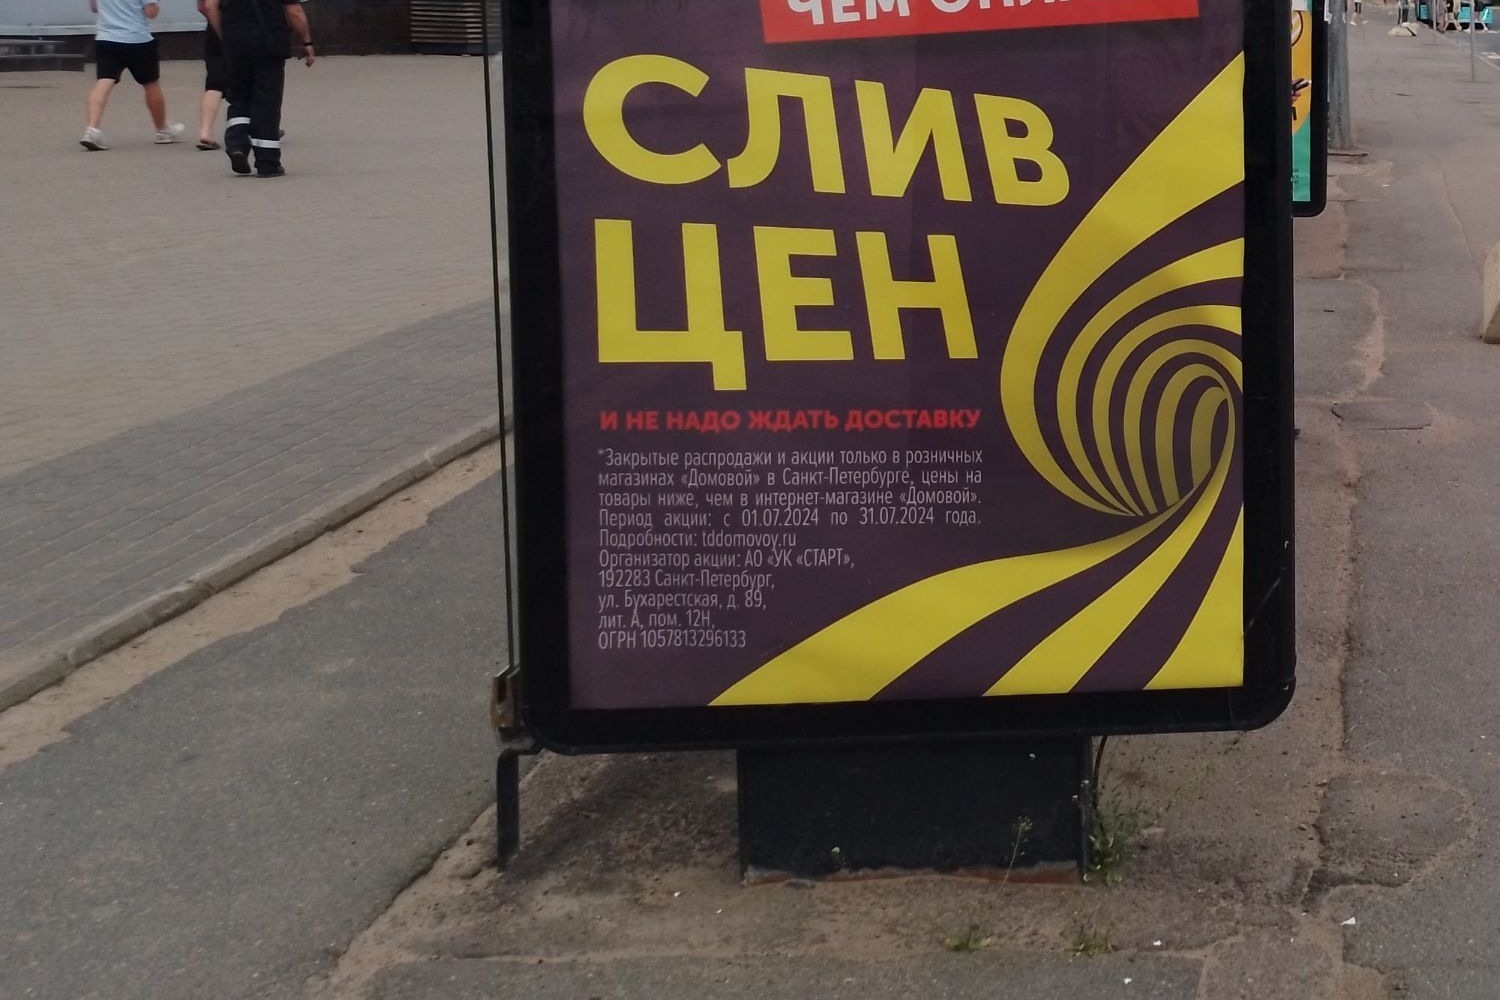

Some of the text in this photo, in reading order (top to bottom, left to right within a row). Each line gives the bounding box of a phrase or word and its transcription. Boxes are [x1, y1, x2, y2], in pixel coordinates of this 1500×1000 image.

[583, 54, 1070, 206] СЛИВ
[594, 218, 979, 391] ЦЕН
[600, 408, 982, 433] И НЕ НАДО ЖДАТЬ ДОСТАВКУ
[684, 451, 772, 469] распродажи
[777, 452, 786, 465] и
[791, 451, 835, 465] акции
[840, 451, 887, 464] только
[892, 451, 900, 464] в
[905, 450, 983, 468] розничных
[599, 467, 982, 489] магазинах «Домовой» в Санкт-Петербурге, цены на
[599, 487, 982, 510] товары ниже, чем в интернет-магазине «Домовой».
[600, 506, 982, 529] Период акции: с 01.07.2024 по 31.07.2024 года.
[600, 529, 796, 553] Подробности: tddomovoy.ru
[600, 548, 855, 570] Организатор акции: АО «УК «СТАРТ»,
[599, 569, 775, 590] 192283 Санкт-Петербург,
[599, 594, 619, 613] ул.
[624, 589, 723, 612] Бухарестская,
[744, 589, 767, 610] 89,
[599, 609, 716, 629] лит. А, пом. 12Н,
[598, 630, 746, 650] ОГРН 1057813296133
